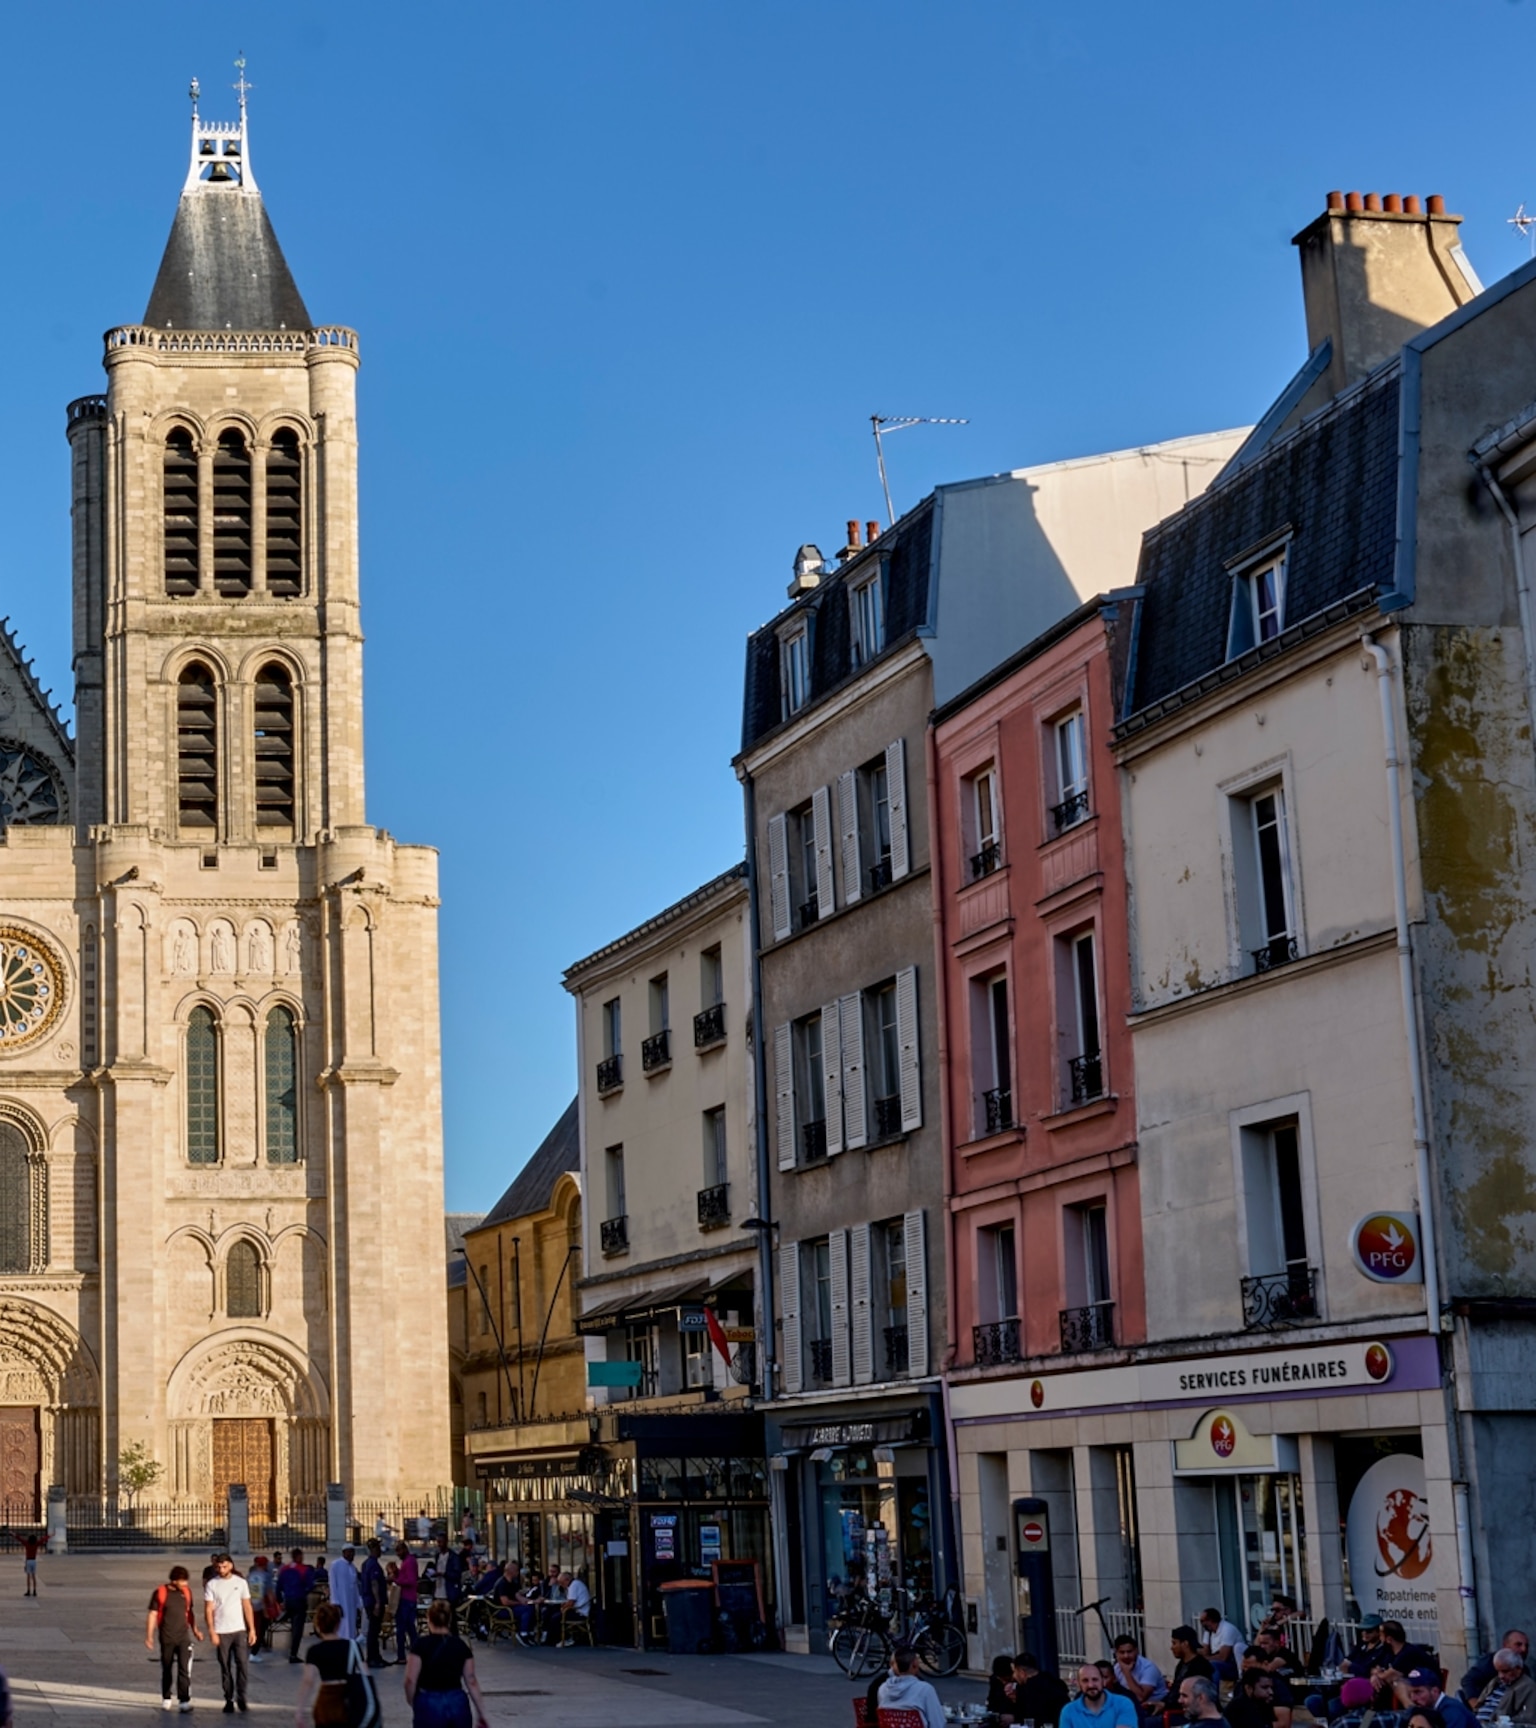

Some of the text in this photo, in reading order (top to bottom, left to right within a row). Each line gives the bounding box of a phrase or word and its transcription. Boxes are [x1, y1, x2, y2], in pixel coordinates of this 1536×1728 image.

[1370, 1252, 1406, 1268] PFG
[727, 1330, 753, 1338] Tabac
[1180, 1361, 1347, 1391] SERVICES FUNÉRAIRES
[1215, 1439, 1233, 1451] PFG
[1376, 1588, 1436, 1603] Rapatrieme
[1378, 1607, 1438, 1620] monde enti
